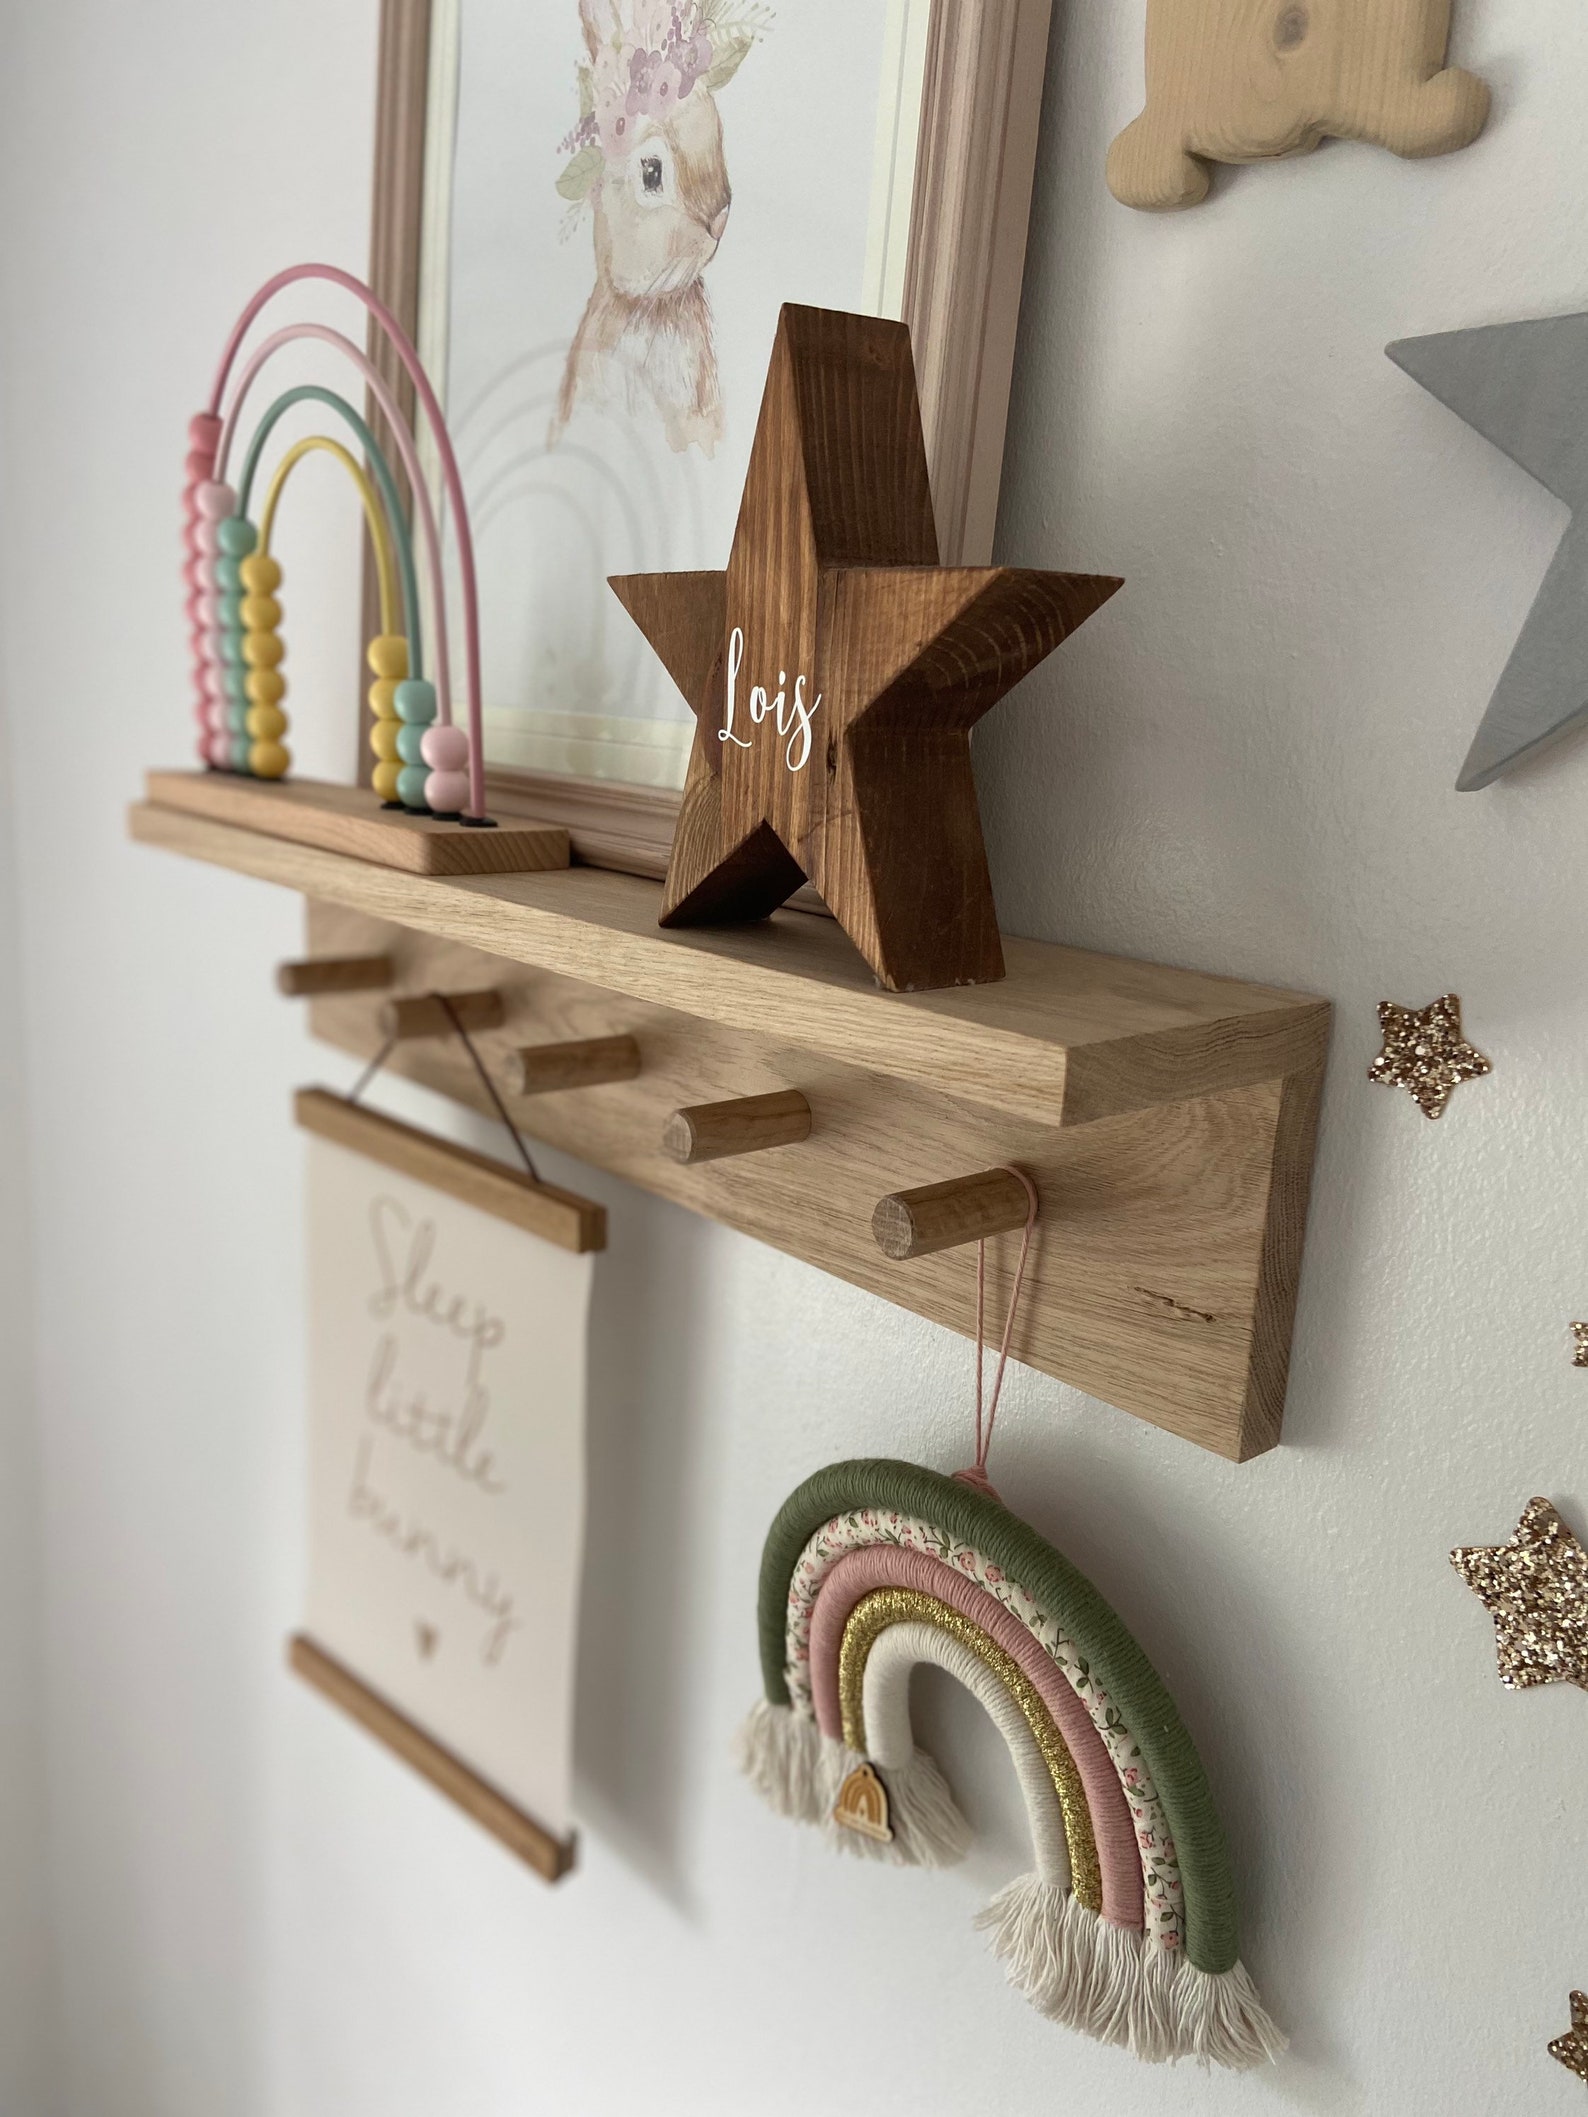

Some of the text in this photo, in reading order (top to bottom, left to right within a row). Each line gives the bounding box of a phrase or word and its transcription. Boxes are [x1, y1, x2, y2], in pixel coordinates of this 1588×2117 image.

[718, 627, 821, 771] Lois
[366, 1331, 508, 1496] little
[348, 1431, 523, 1668] bunny
